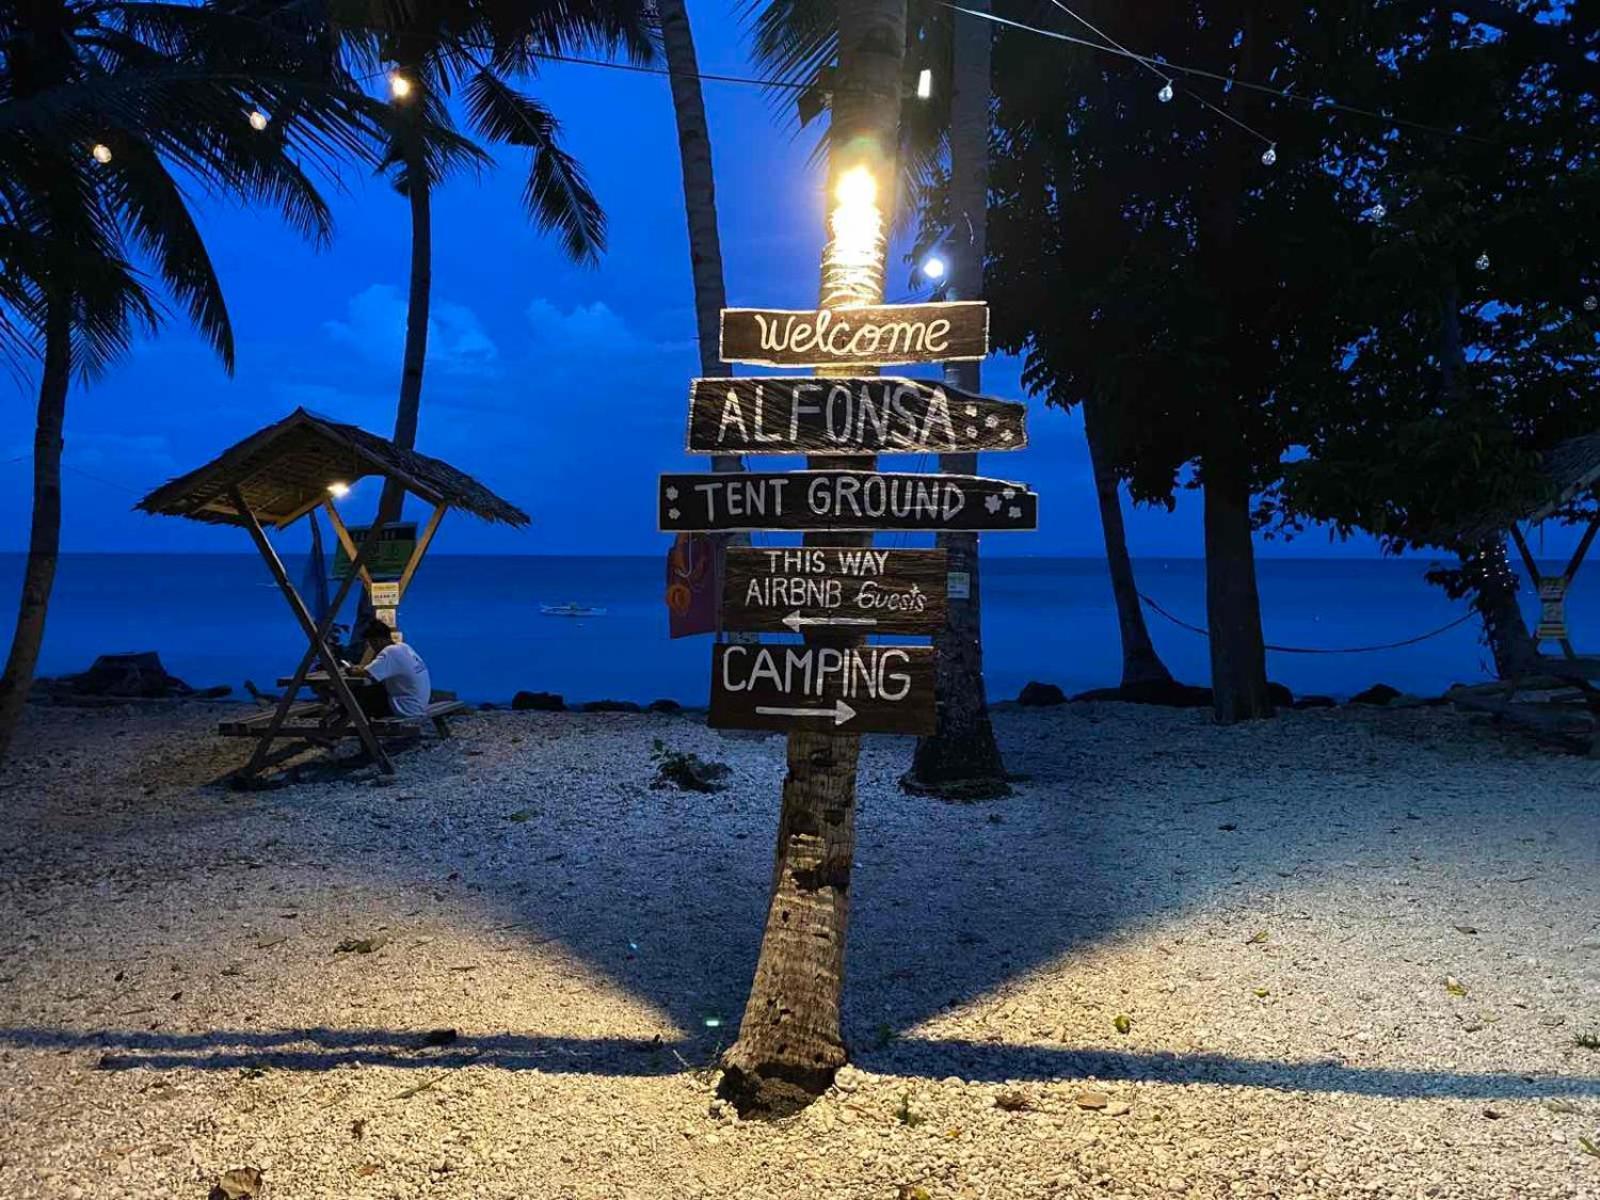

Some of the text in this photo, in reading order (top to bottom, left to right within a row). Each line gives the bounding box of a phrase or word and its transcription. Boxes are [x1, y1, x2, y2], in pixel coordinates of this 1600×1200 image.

[755, 309, 950, 356] Welcome
[717, 384, 957, 450] ALFONSA
[693, 476, 966, 522] TENT GROUND
[768, 550, 891, 576] THIS WAY
[745, 577, 842, 609] AIRBNB
[855, 581, 928, 612] Guests
[722, 645, 912, 701] CAMPING
